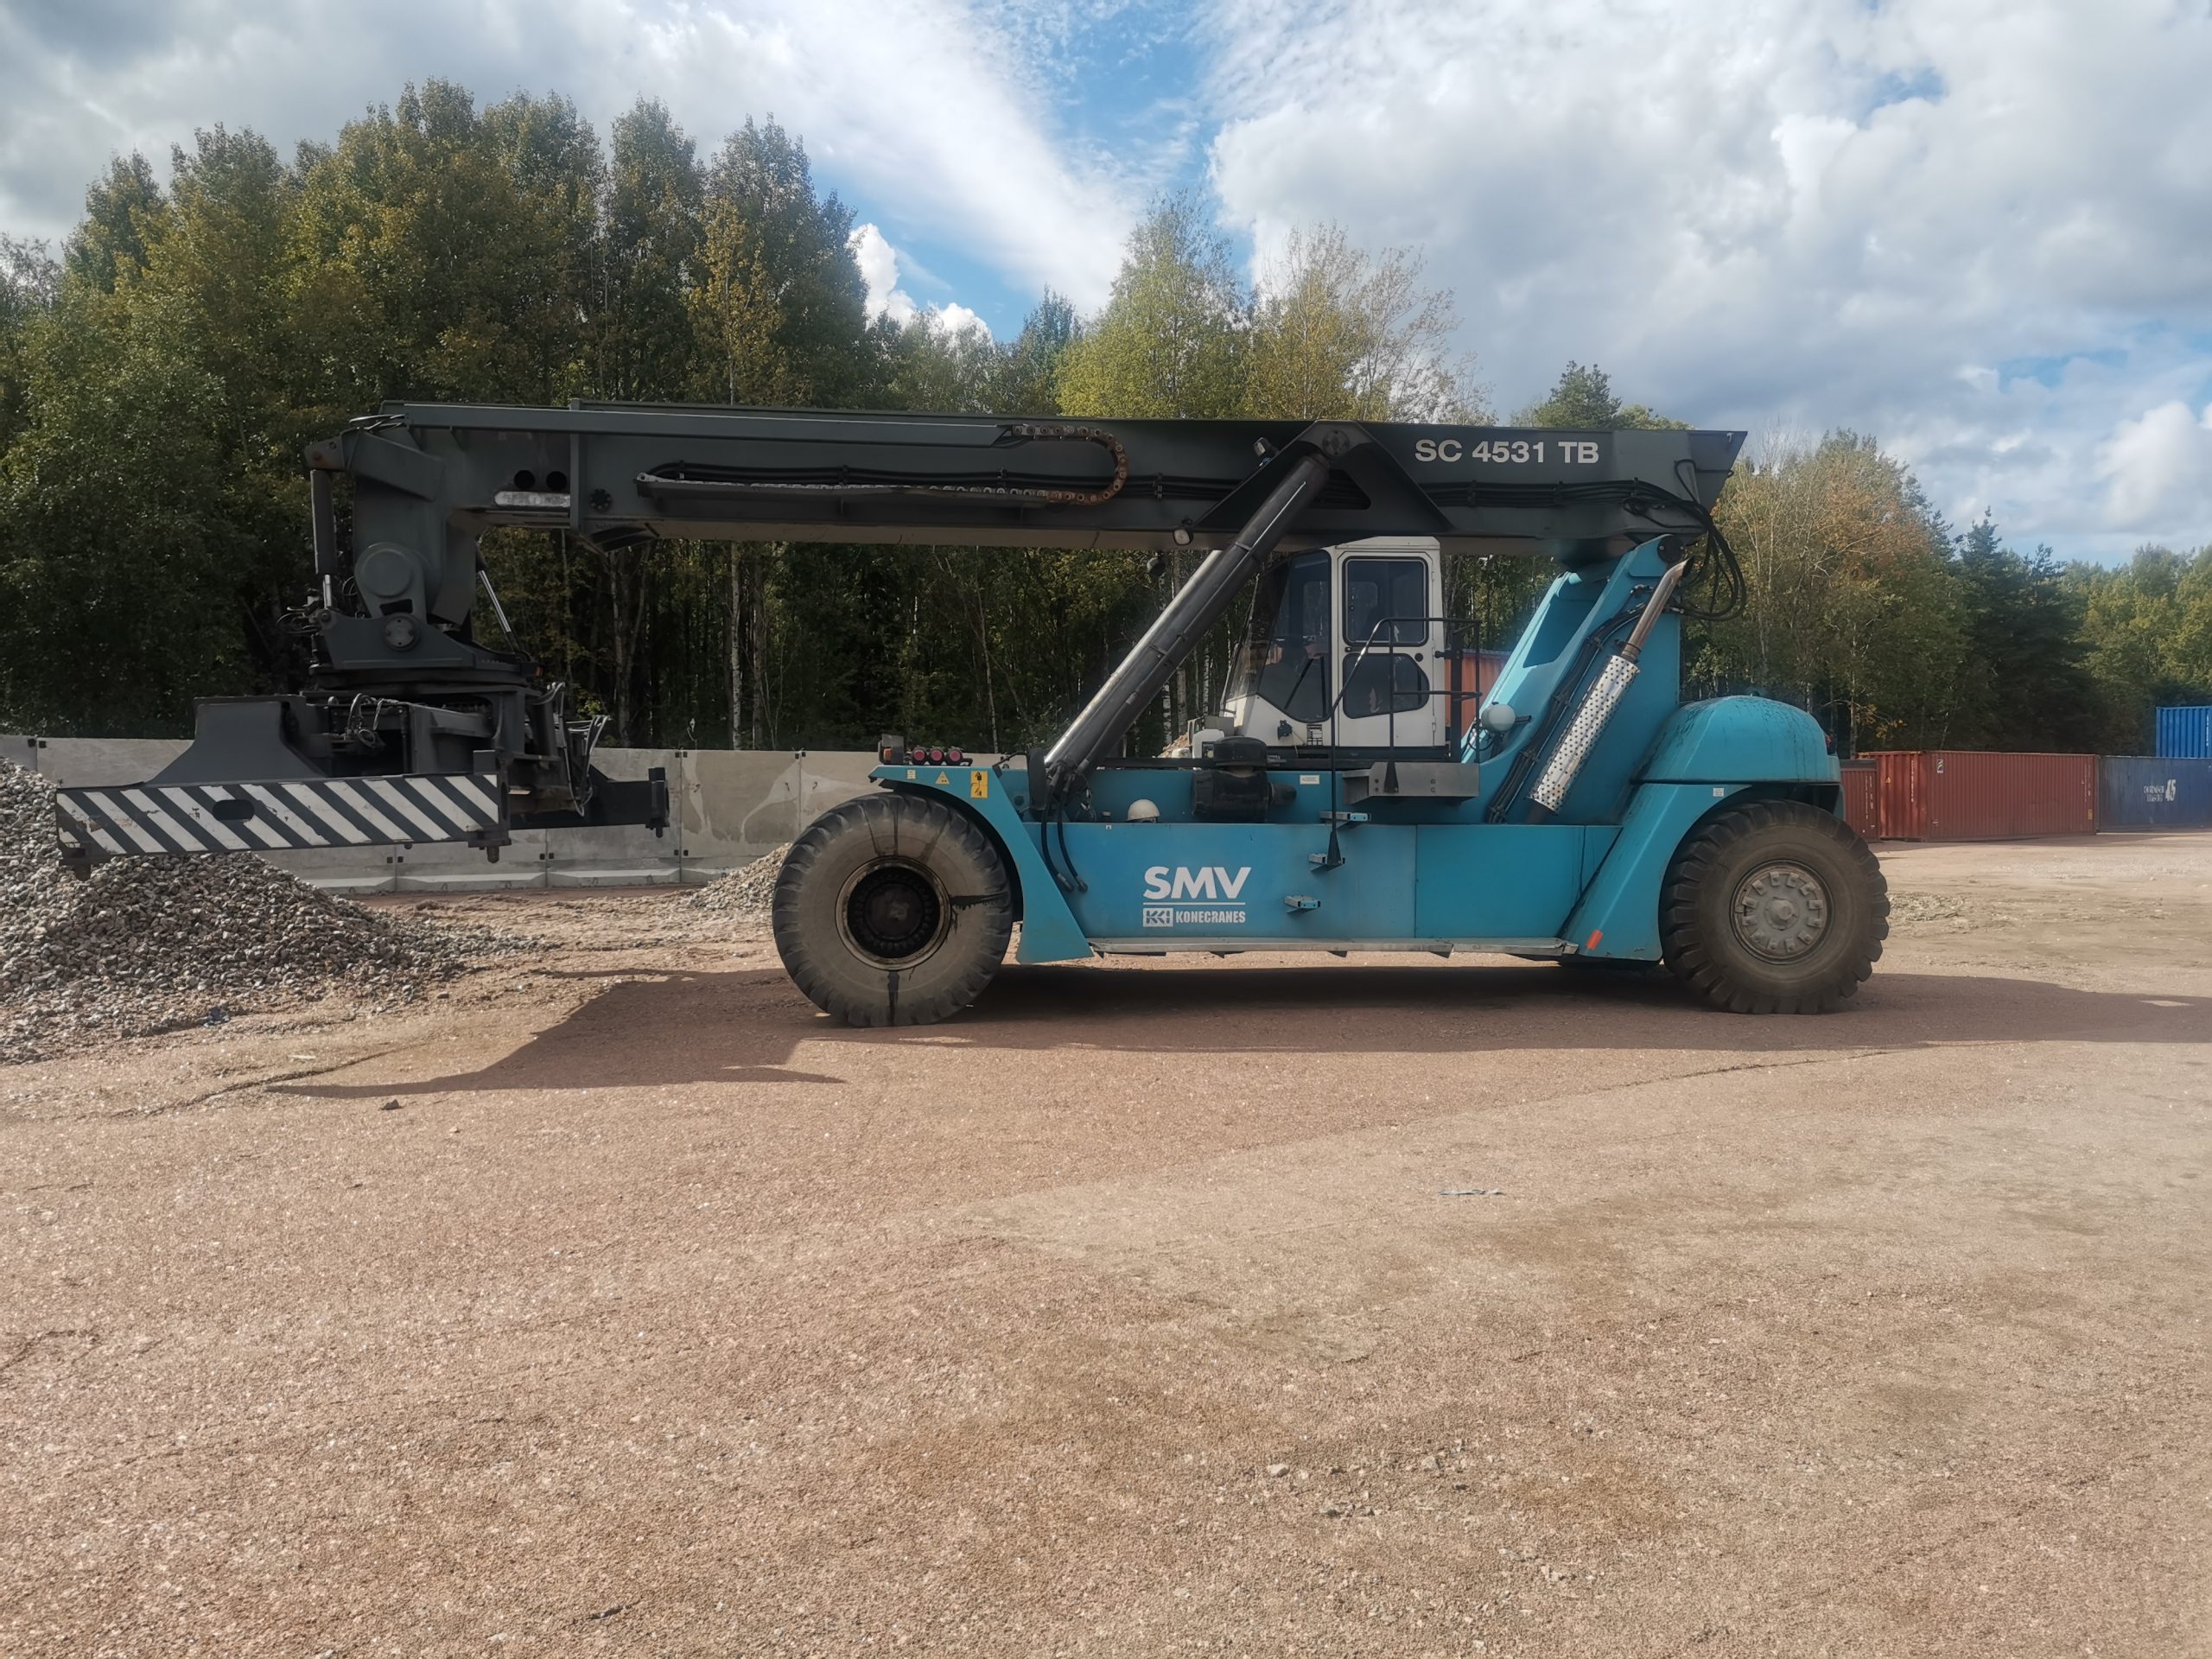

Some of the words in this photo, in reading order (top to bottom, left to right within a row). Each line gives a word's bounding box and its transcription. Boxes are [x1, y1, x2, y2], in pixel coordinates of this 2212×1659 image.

[1414, 439, 1462, 462] SC
[1472, 442, 1545, 463] 4531
[1558, 442, 1599, 464] TB
[1142, 866, 1251, 899] SMV
[1176, 911, 1246, 924] KONECRANES
